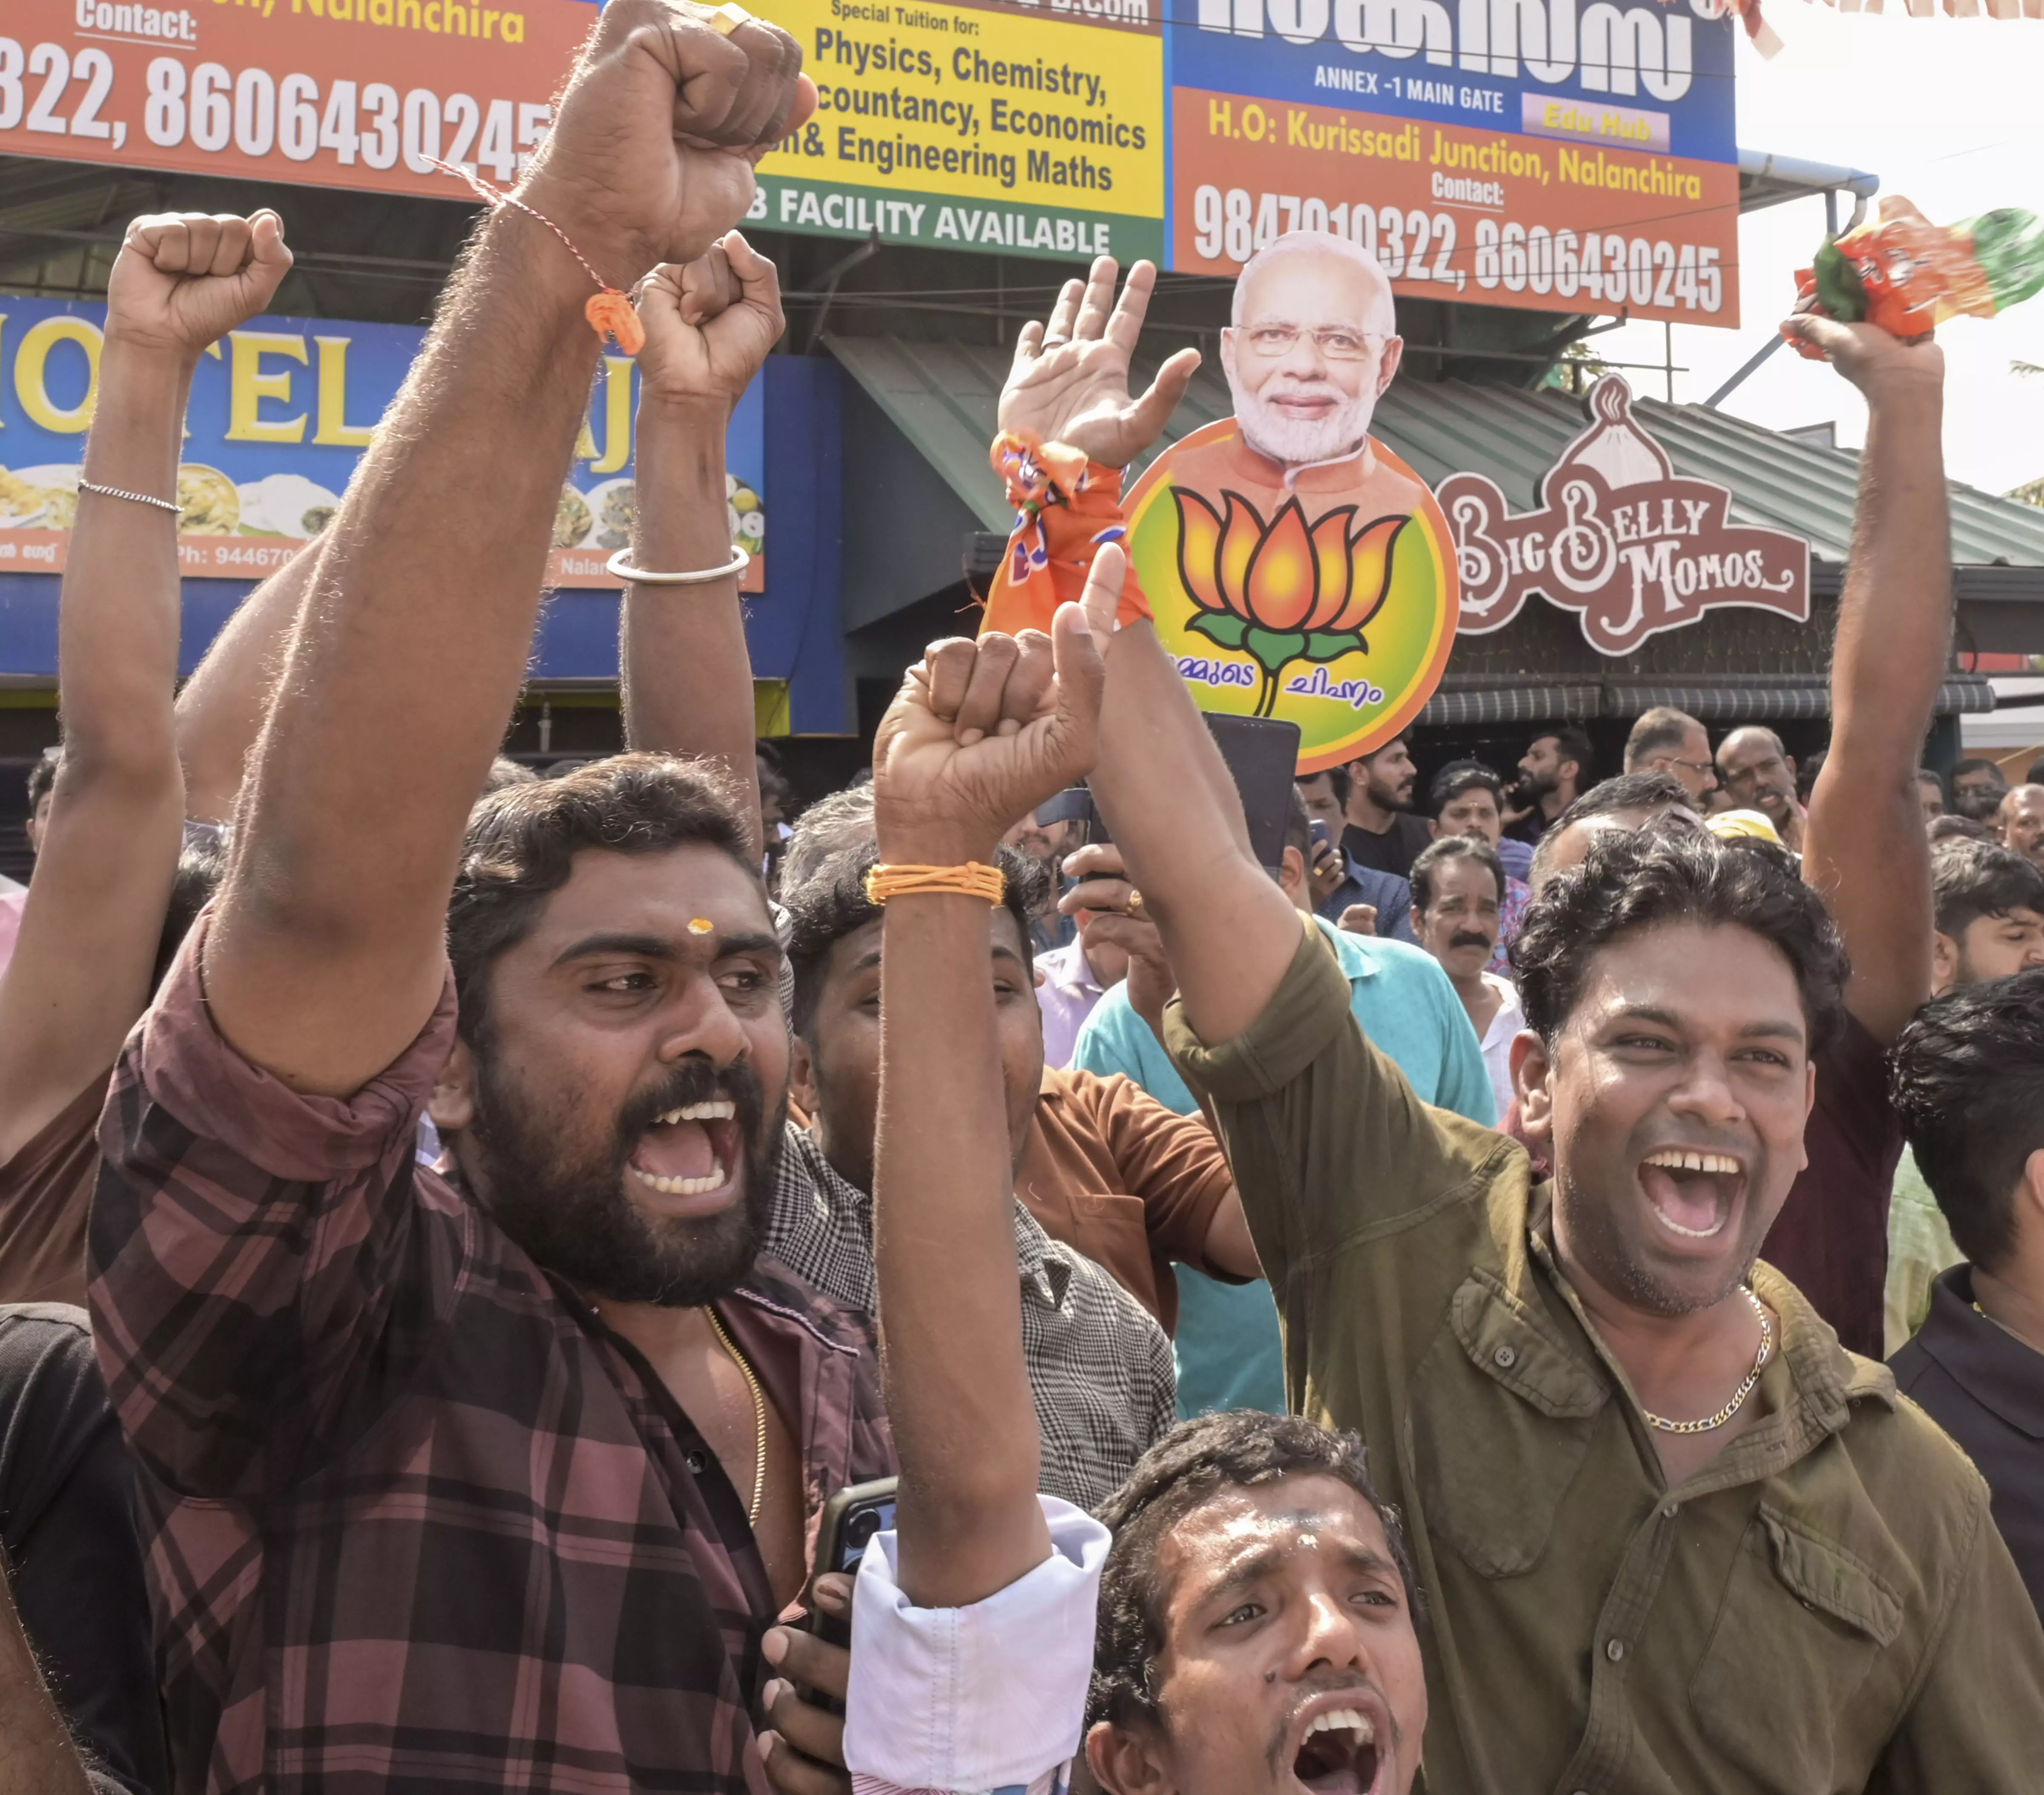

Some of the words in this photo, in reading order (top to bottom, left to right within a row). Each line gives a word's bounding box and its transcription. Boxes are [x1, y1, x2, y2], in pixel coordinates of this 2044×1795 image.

[76, 0, 197, 41] Contact:
[831, 0, 890, 23] Special
[895, 7, 948, 32] Tuition
[953, 16, 979, 36] for:
[815, 27, 941, 84] Physics,
[953, 47, 1106, 107] Chemistry,
[1314, 65, 1378, 94] ANNEX
[1407, 78, 1454, 106] MAIN
[1460, 86, 1504, 113] GATE
[990, 98, 1146, 150] Economics
[1209, 98, 1276, 143] H.O:
[1287, 109, 1420, 161] Kurissadi
[1429, 129, 1550, 186] Junction,
[1559, 147, 1701, 199] Nalanchira
[1543, 103, 1593, 133] Edu
[1600, 112, 1650, 141] Hub
[838, 126, 1016, 189] Engineering
[1027, 149, 1113, 191] Maths
[1431, 171, 1504, 206] Contact:
[780, 188, 927, 236] FACILITY
[933, 206, 1110, 255] AVAILABLE
[1475, 218, 1722, 313] 8606430245
[1452, 495, 1546, 616] BIG
[1550, 479, 1710, 593] BELLY
